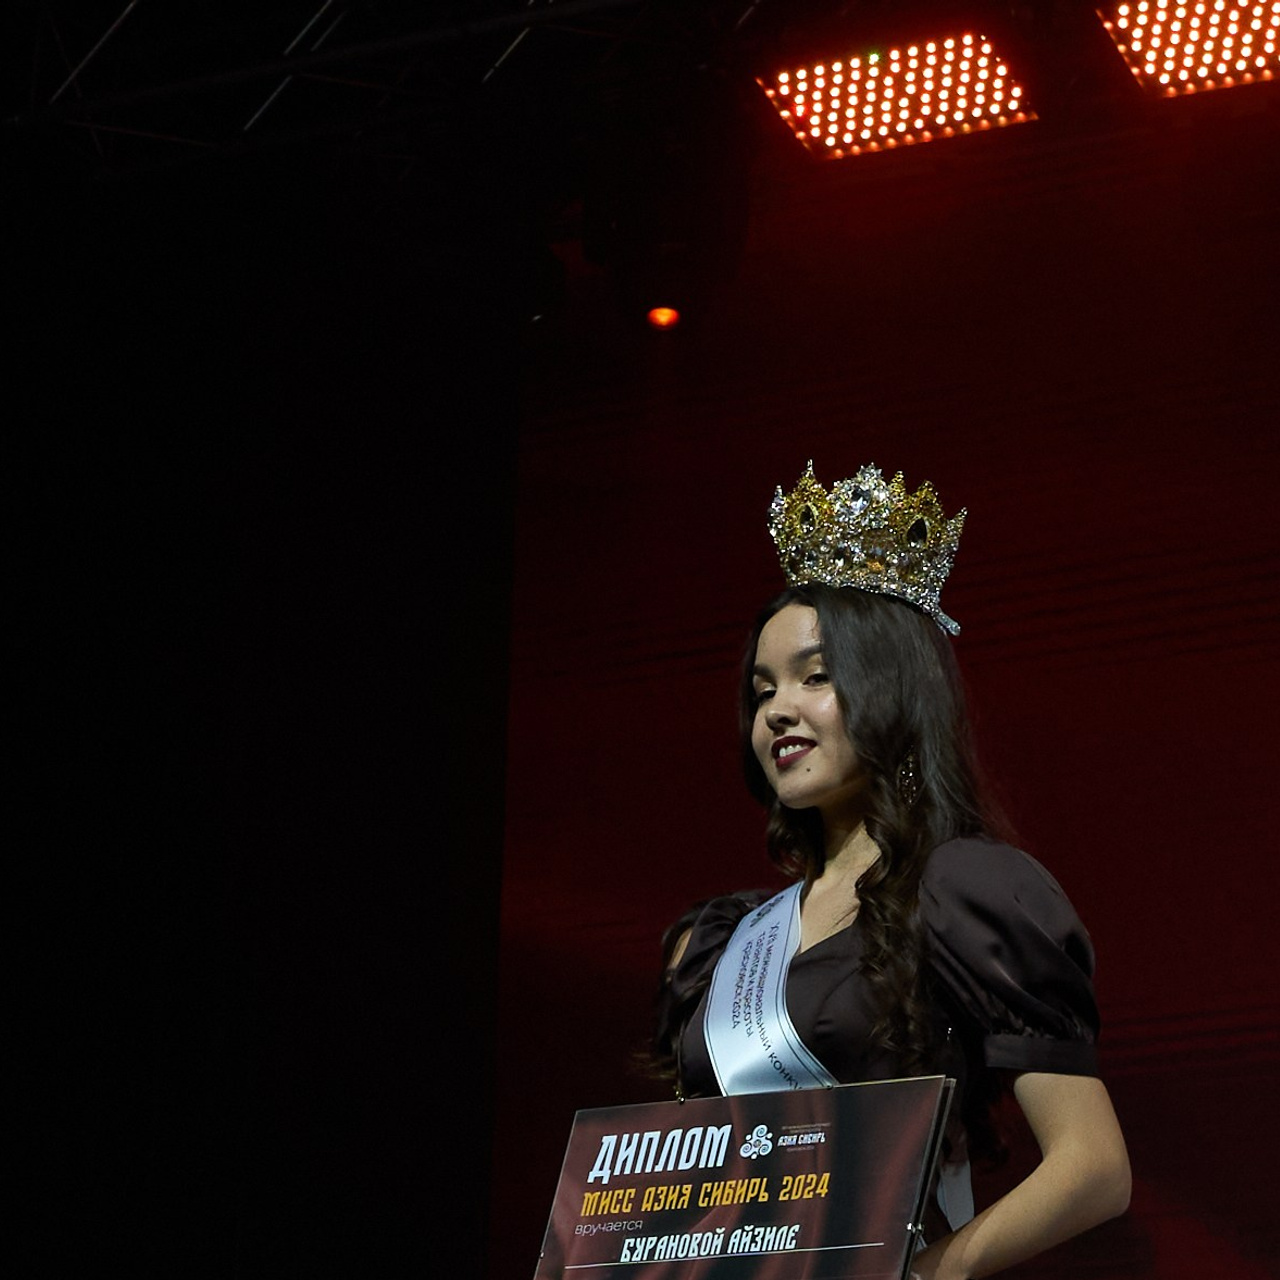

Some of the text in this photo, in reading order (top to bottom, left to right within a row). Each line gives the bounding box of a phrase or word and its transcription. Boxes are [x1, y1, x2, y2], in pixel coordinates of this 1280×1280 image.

[587, 1124, 732, 1185] ДИПЛОМ
[580, 1172, 831, 1217] МИСС АЗИЯ СИБИРЬ 2024
[574, 1220, 643, 1237] вручается
[620, 1224, 800, 1263] БУРАНОВОЙ АЙЗИЛЕ
